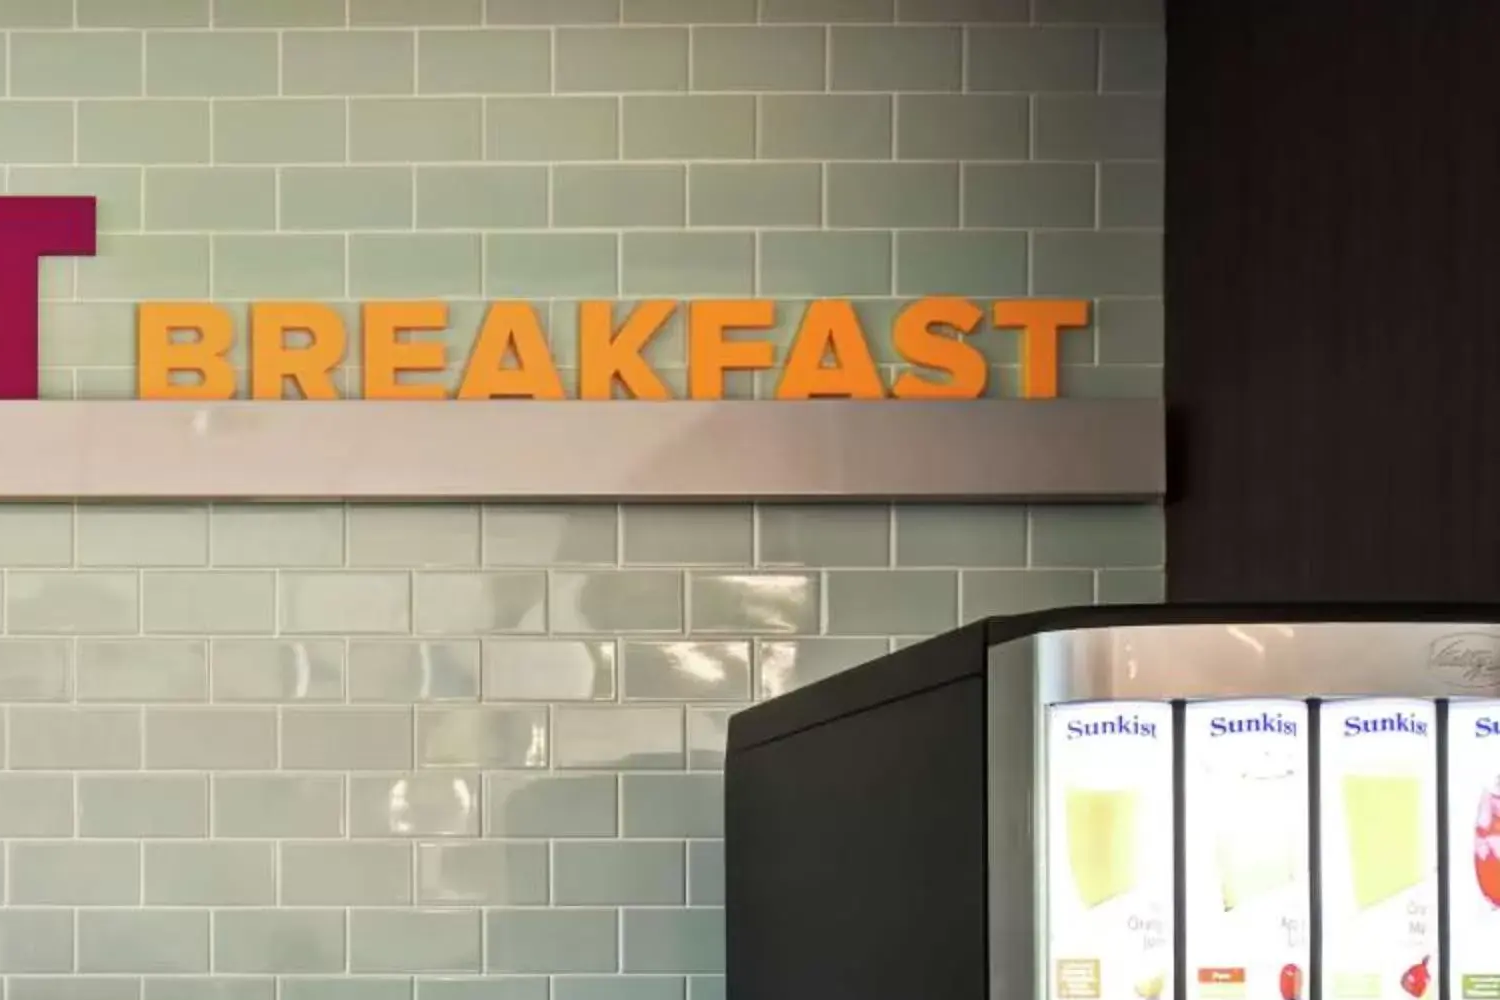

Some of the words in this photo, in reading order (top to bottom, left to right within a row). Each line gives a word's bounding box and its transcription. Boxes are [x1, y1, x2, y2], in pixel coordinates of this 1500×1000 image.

[136, 296, 1090, 401] BREAKFAST
[1067, 713, 1157, 740] Sunkist
[1209, 712, 1297, 738] Sunkist
[1343, 712, 1428, 738] Sunkist
